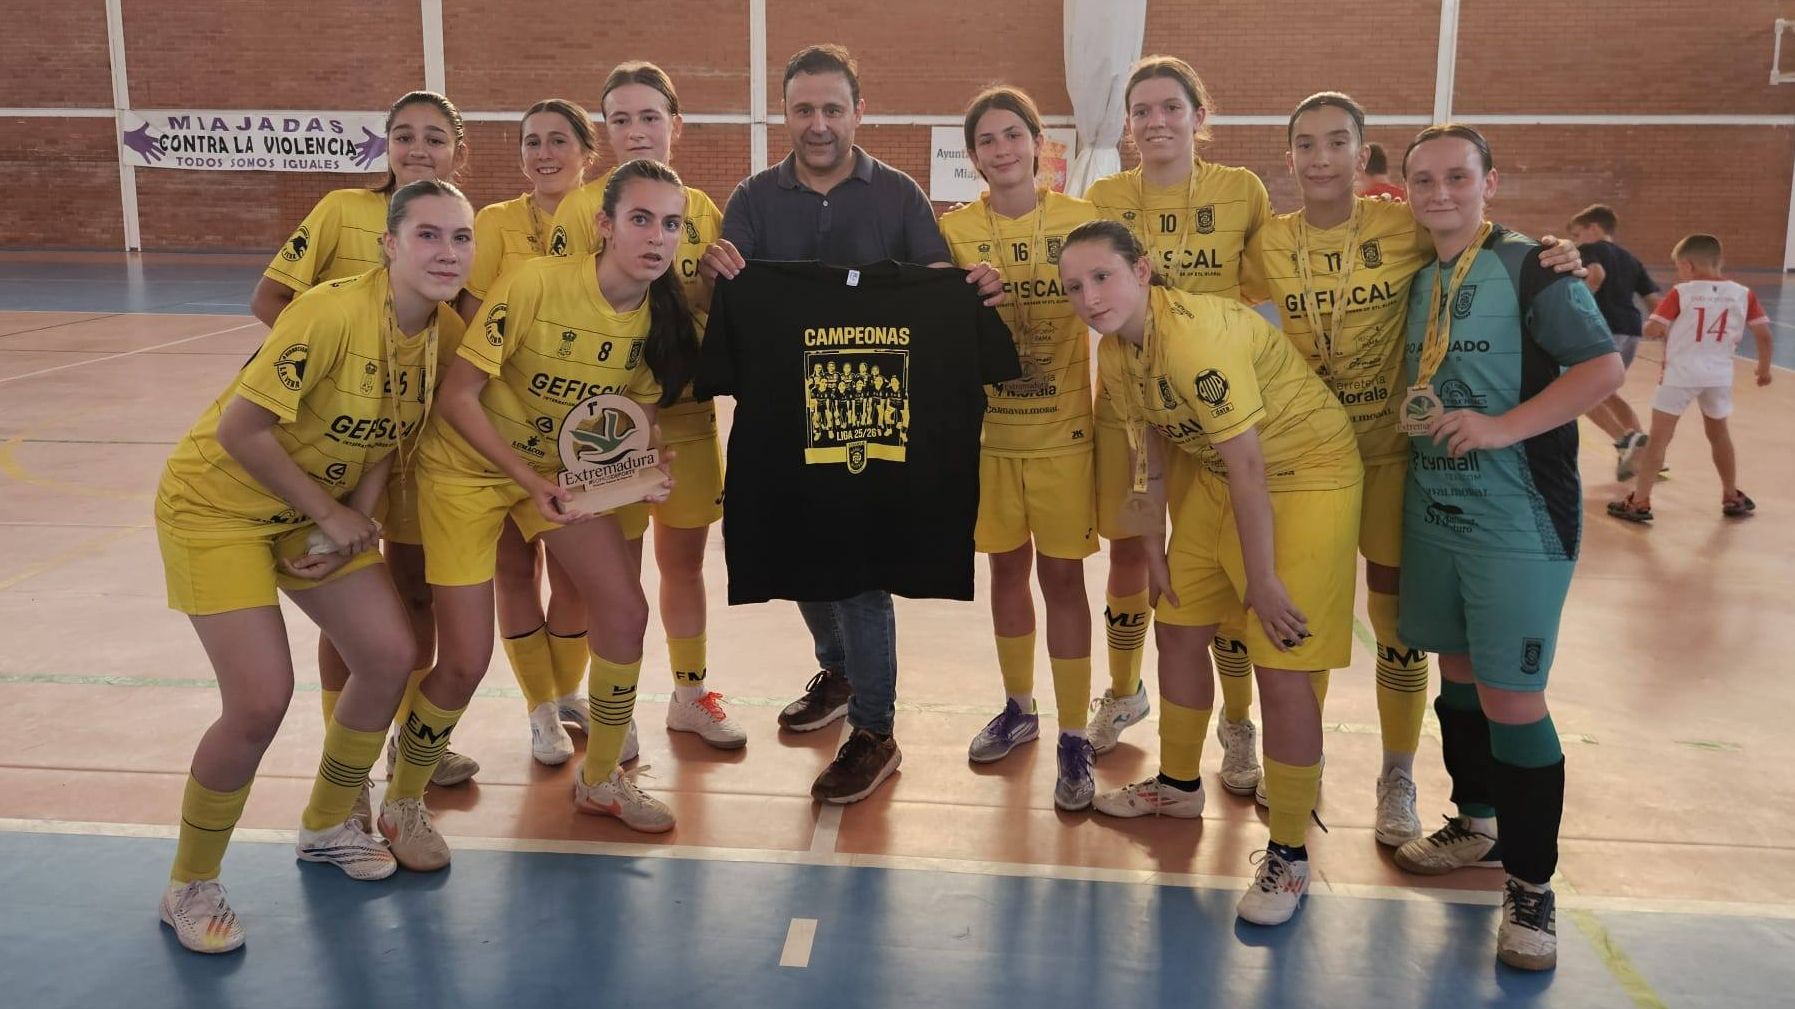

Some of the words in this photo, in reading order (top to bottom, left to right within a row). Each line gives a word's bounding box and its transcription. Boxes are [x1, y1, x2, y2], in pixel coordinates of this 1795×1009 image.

[168, 116, 345, 134] MIAJADAS
[159, 134, 230, 154] CONTRA
[234, 136, 255, 154] LA
[264, 136, 358, 157] VIOLENCIA
[936, 149, 970, 159] Ayunt
[176, 156, 224, 168] TODOS
[230, 157, 276, 169] SOMOS
[283, 158, 341, 170] IGUALES
[1159, 214, 1177, 233] 10
[1011, 242, 1029, 262] 16
[1693, 307, 1729, 342] 14
[804, 327, 910, 346] CAMPEONAS
[597, 341, 613, 362] 8
[836, 430, 853, 441] LIGA
[854, 428, 877, 438] 25/26
[564, 454, 655, 486] Extremadura
